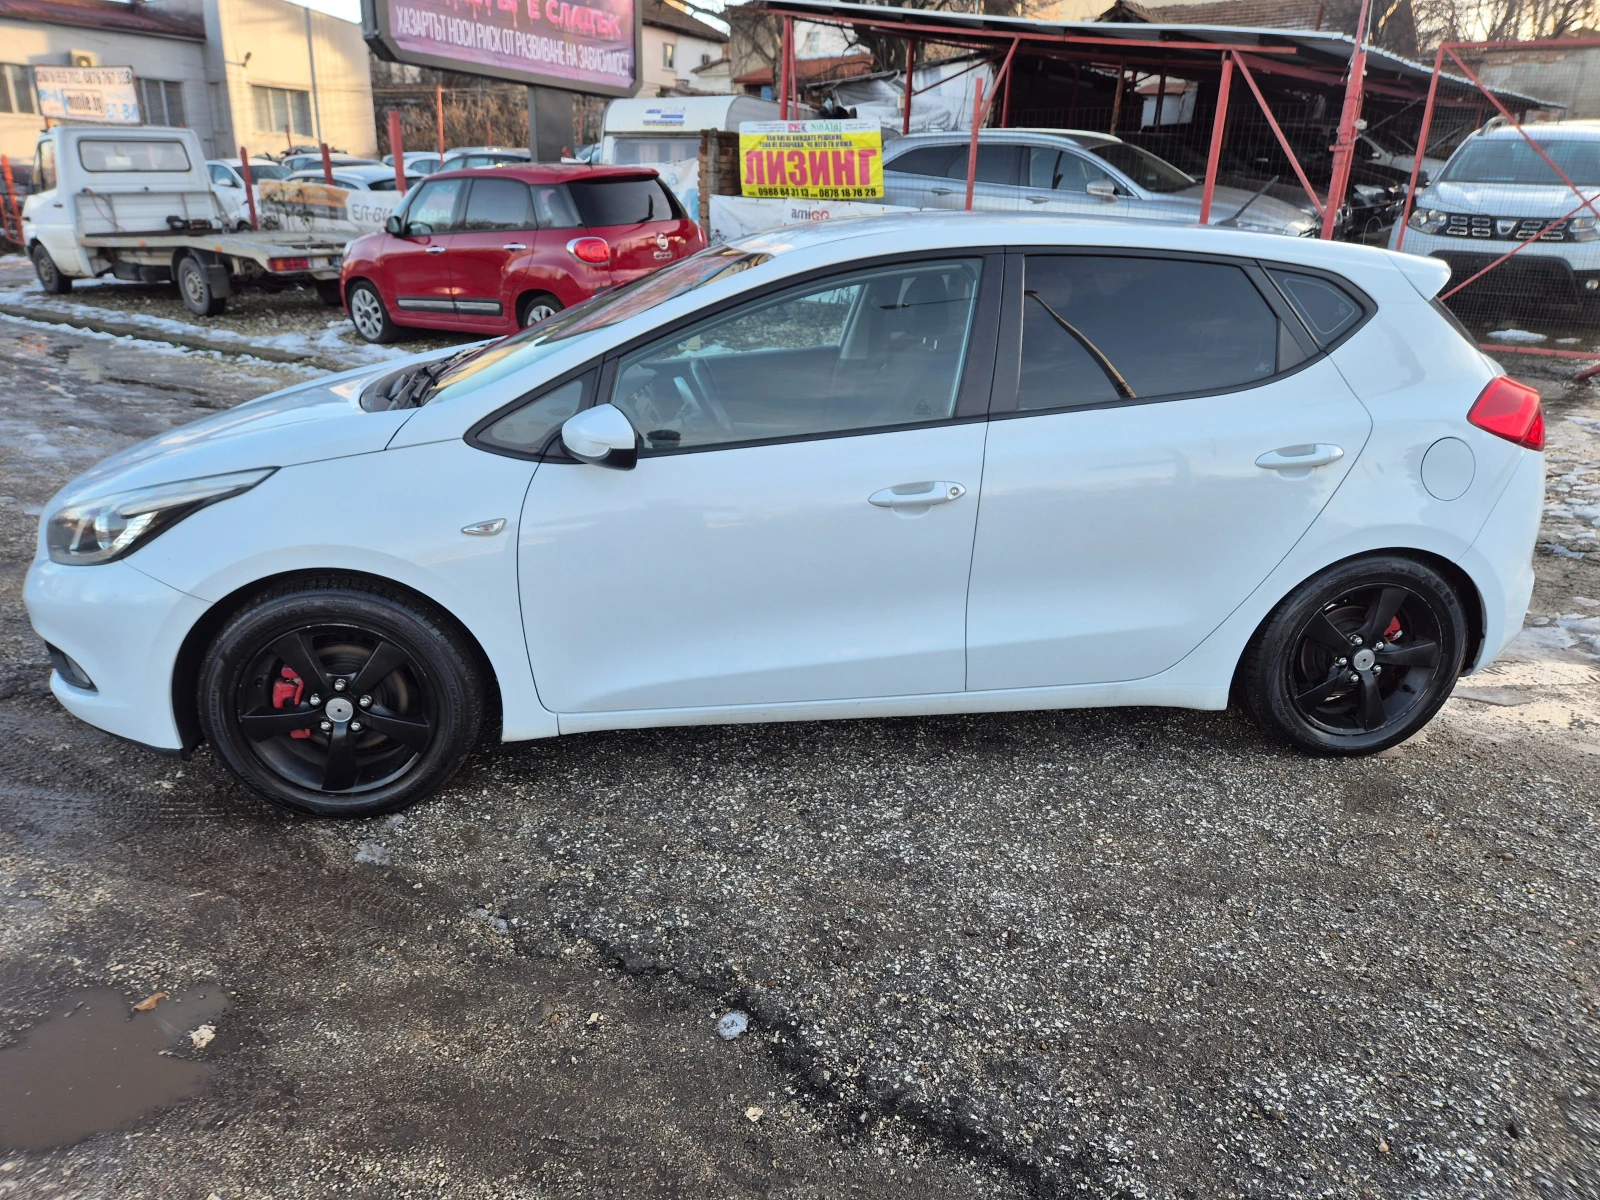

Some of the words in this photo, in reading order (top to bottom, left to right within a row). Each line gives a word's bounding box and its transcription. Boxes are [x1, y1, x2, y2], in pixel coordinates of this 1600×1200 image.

[546, 0, 622, 38] СЛАДЪК
[395, 5, 447, 42] ХАЗАРТЪТ
[446, 18, 476, 48] НОСИ
[475, 23, 503, 53] РИСК
[502, 28, 515, 56] ОТ
[515, 30, 566, 66] РАЗВИВАНЕ
[565, 42, 578, 67] НА
[578, 44, 630, 77] ЗАВИСИМОСТ
[745, 148, 877, 186] ЛИЗИНГ
[758, 187, 779, 196] 0988
[780, 187, 790, 197] 84
[791, 188, 799, 197] 31
[800, 188, 809, 197] 13
[819, 188, 839, 198] 0878
[841, 188, 851, 197] 18
[852, 188, 863, 197] 78
[864, 187, 877, 197] 28
